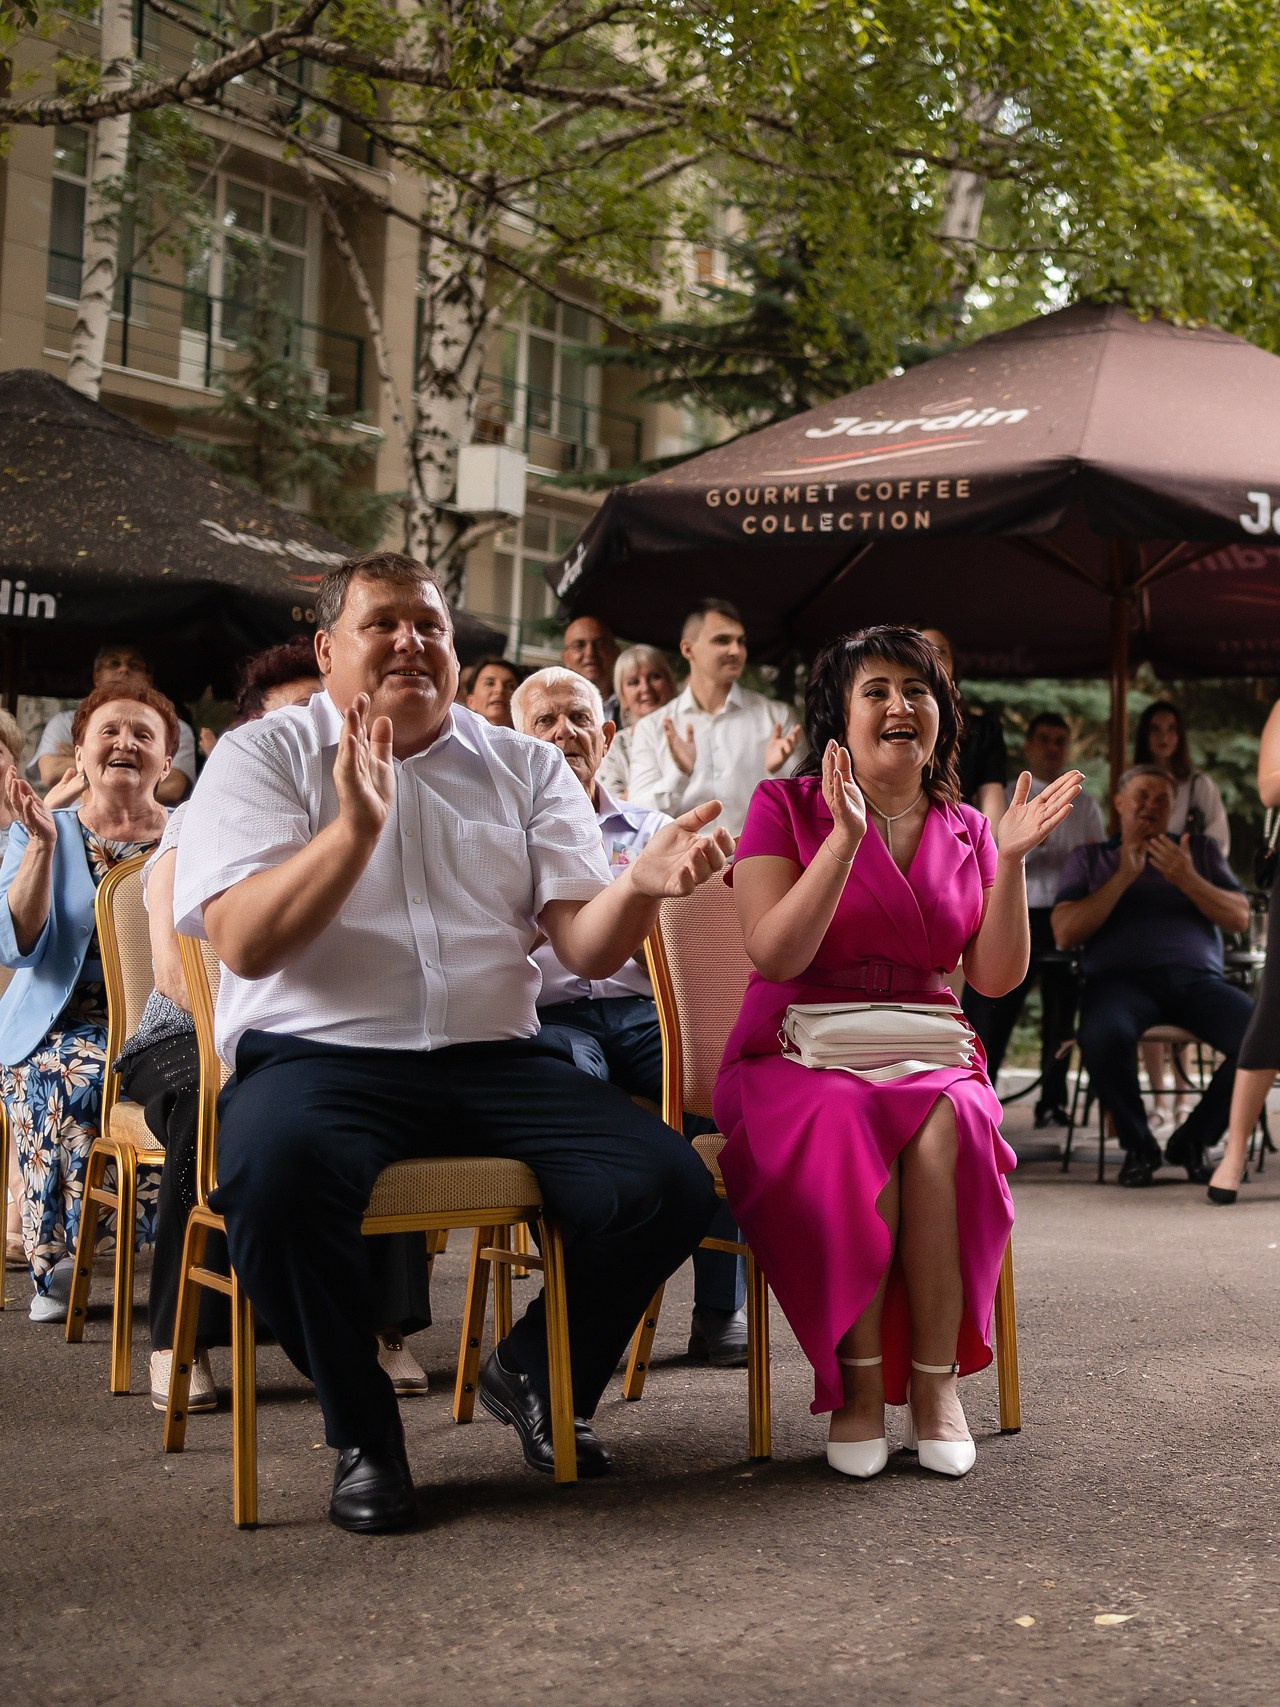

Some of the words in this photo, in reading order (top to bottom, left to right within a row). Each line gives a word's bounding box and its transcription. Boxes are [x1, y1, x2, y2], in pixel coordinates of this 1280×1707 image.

[805, 406, 1029, 439] Jardin
[705, 483, 838, 508] GOURMET
[856, 479, 972, 501] COFFEE
[742, 510, 931, 535] COLLECTION
